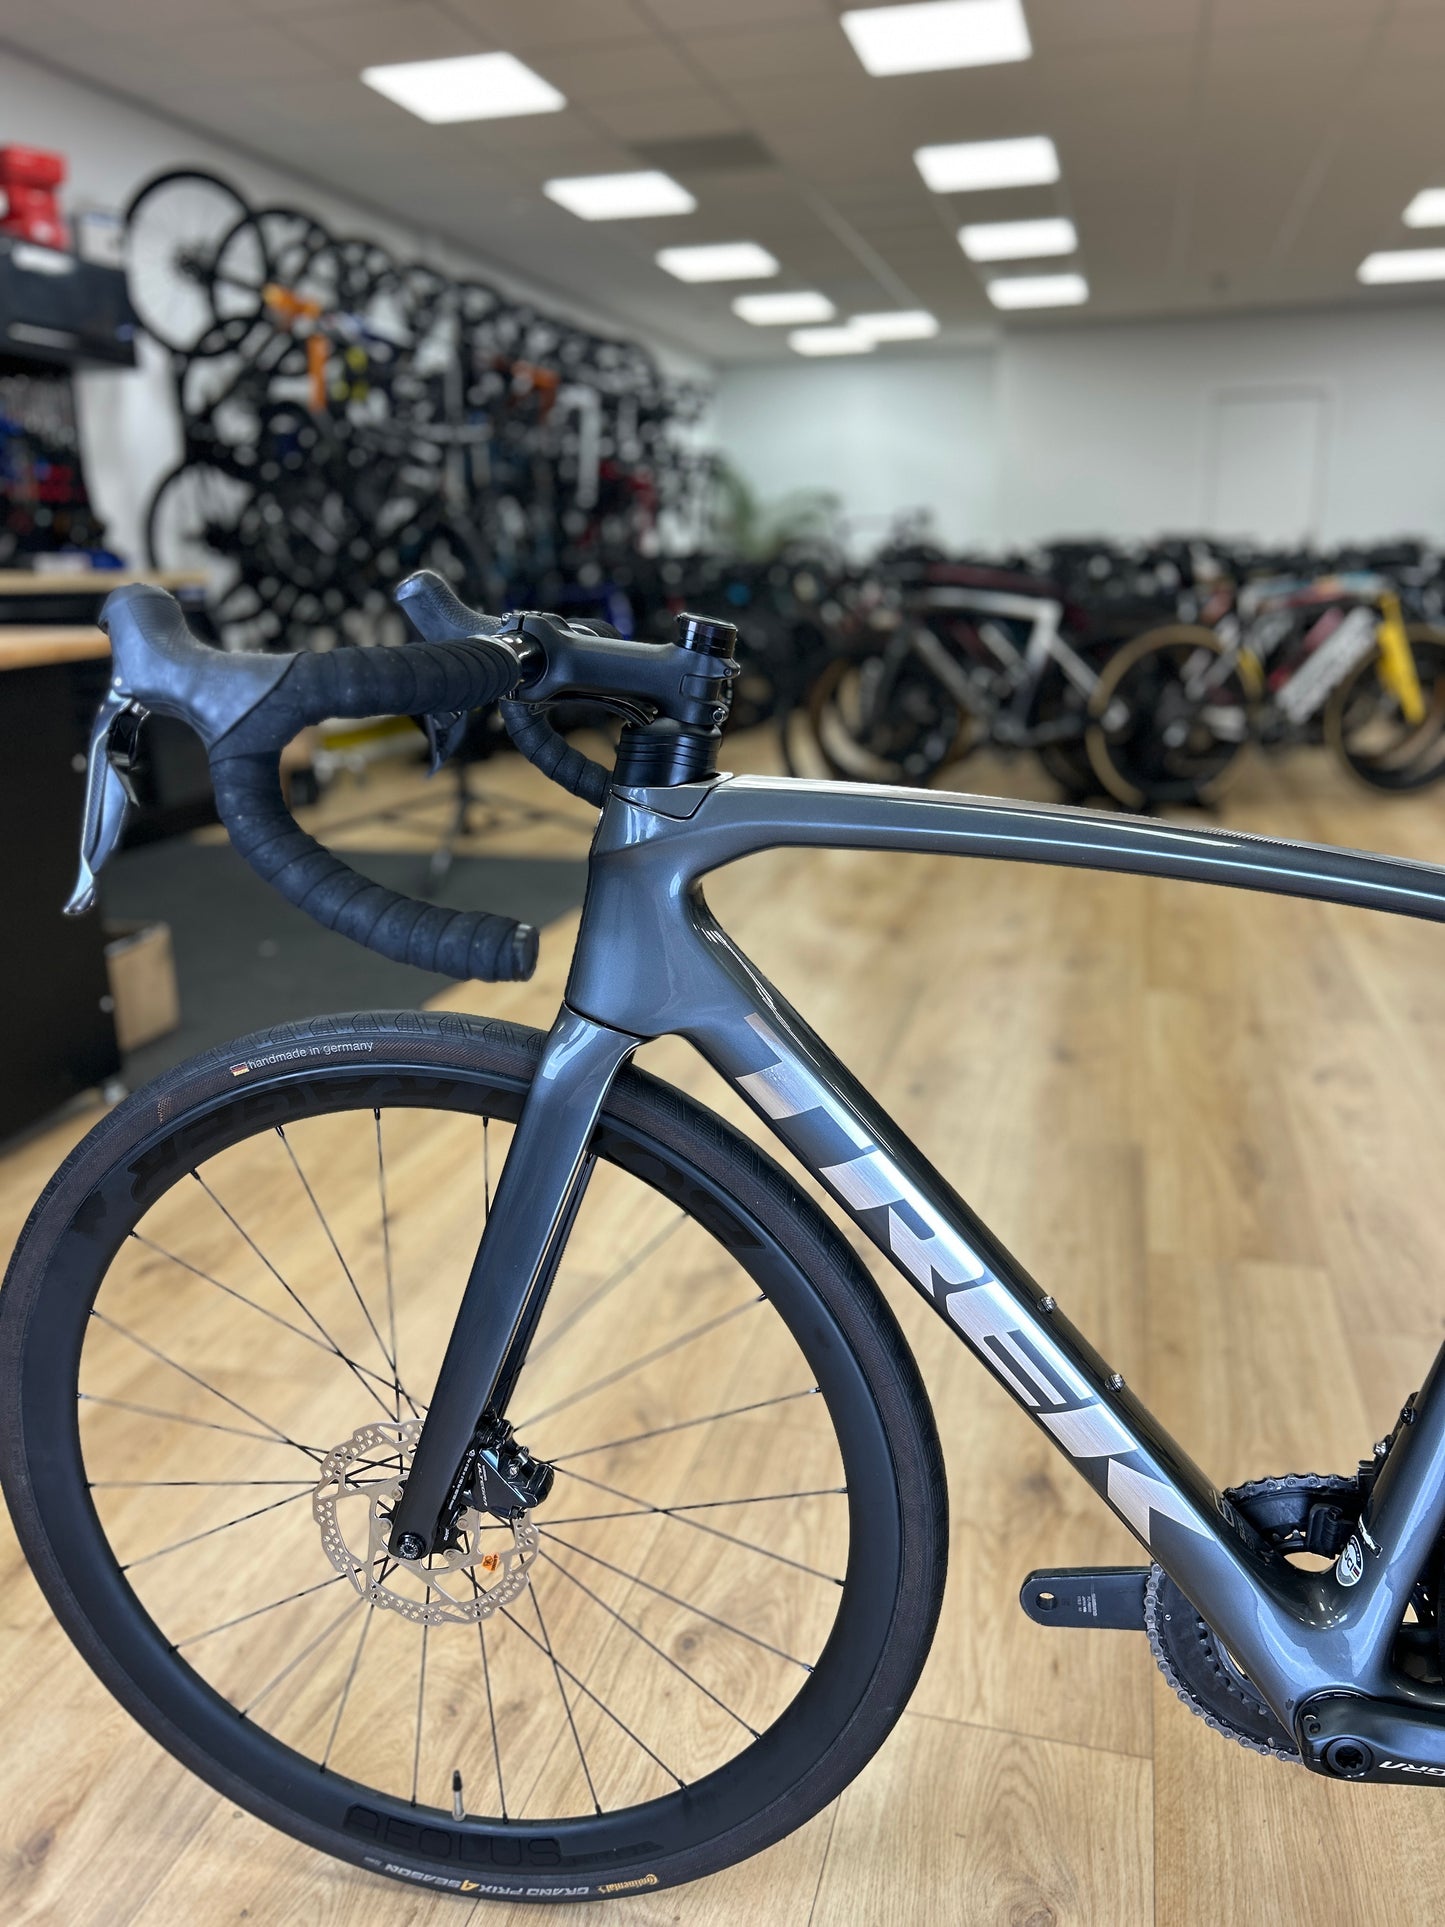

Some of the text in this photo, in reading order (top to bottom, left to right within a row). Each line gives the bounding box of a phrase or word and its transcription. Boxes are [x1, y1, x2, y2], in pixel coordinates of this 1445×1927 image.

[247, 1041, 374, 1070] handmade in germany
[735, 1012, 1218, 1546] TREK
[343, 1804, 562, 1866] AEOLUS
[384, 1863, 659, 1896] Continental GRAND PRIX 4 SEASON
